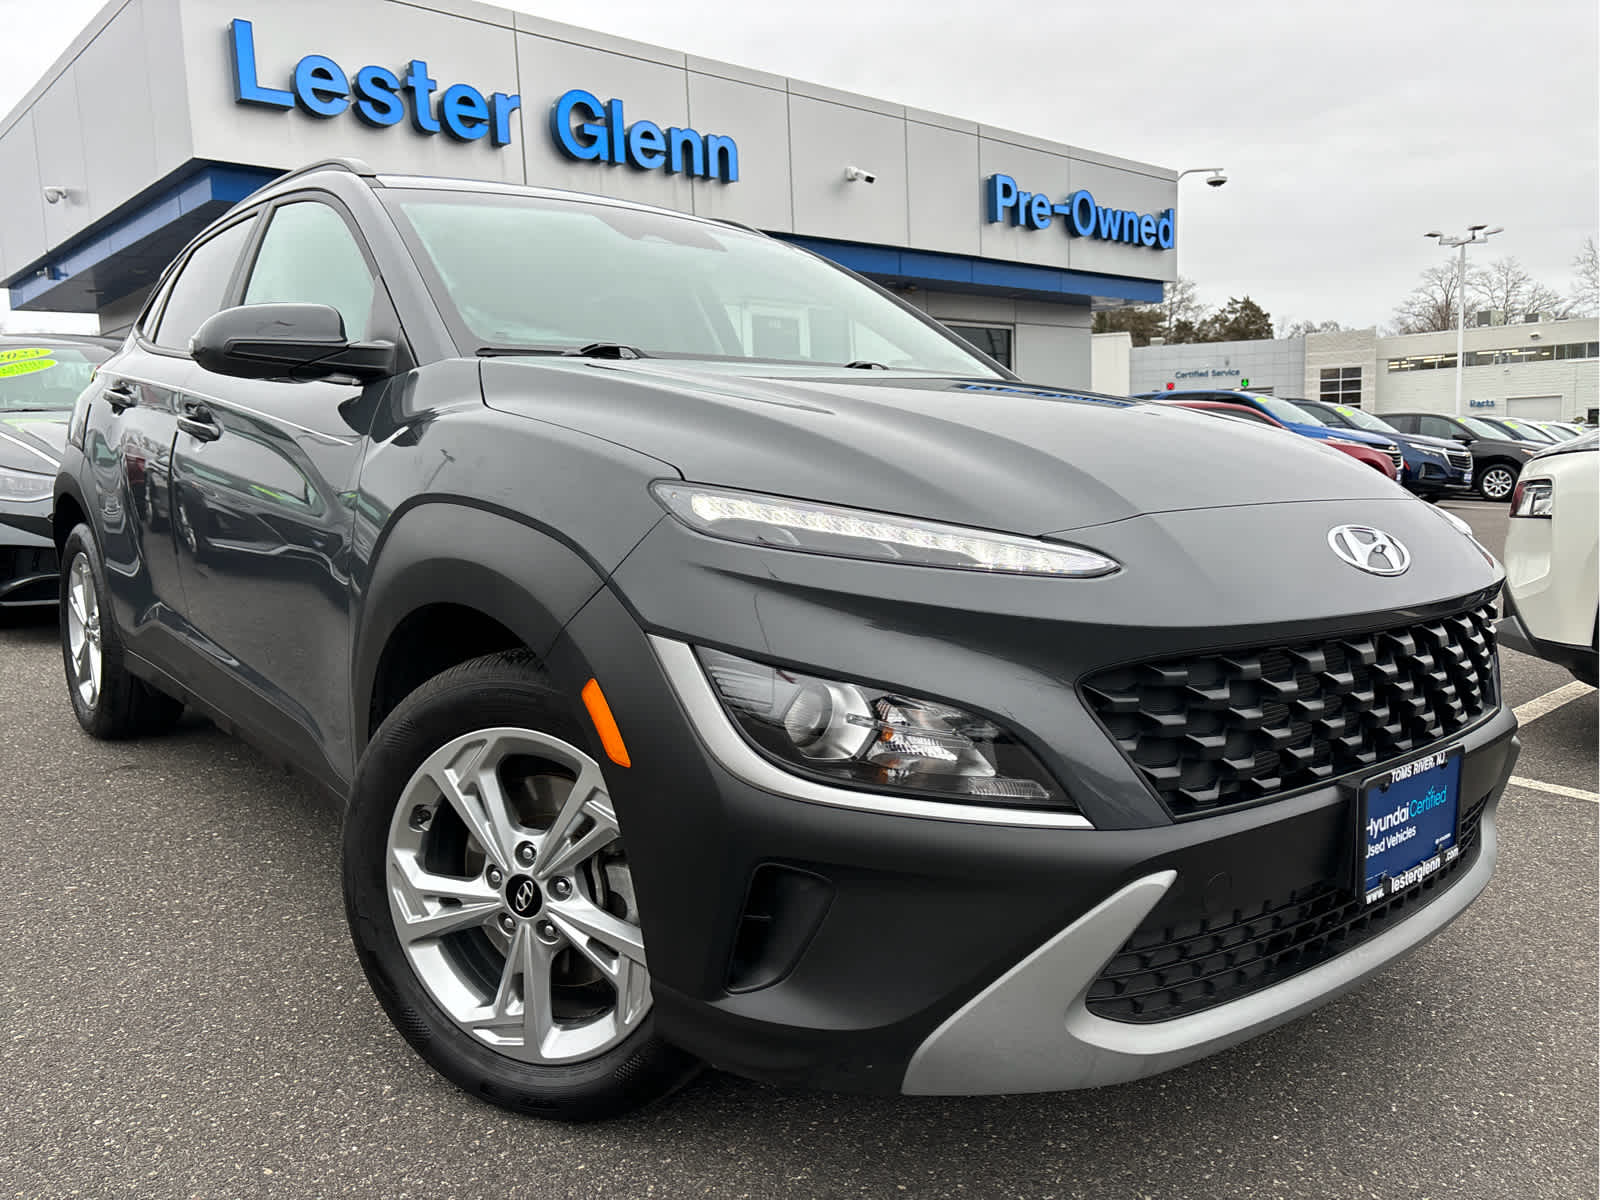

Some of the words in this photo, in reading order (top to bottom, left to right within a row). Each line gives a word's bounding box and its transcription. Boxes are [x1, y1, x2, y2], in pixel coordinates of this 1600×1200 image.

[228, 18, 520, 146] Lester
[552, 89, 739, 183] Glenn
[987, 173, 1175, 249] Pre-Owned
[1175, 370, 1209, 379] Certified
[1211, 368, 1241, 377] Service
[1469, 399, 1495, 408] Parts
[1391, 764, 1412, 783] TOMS
[1410, 784, 1448, 817] Certified
[1386, 825, 1417, 849] Vehicles
[1391, 856, 1441, 893] lesterglenn
